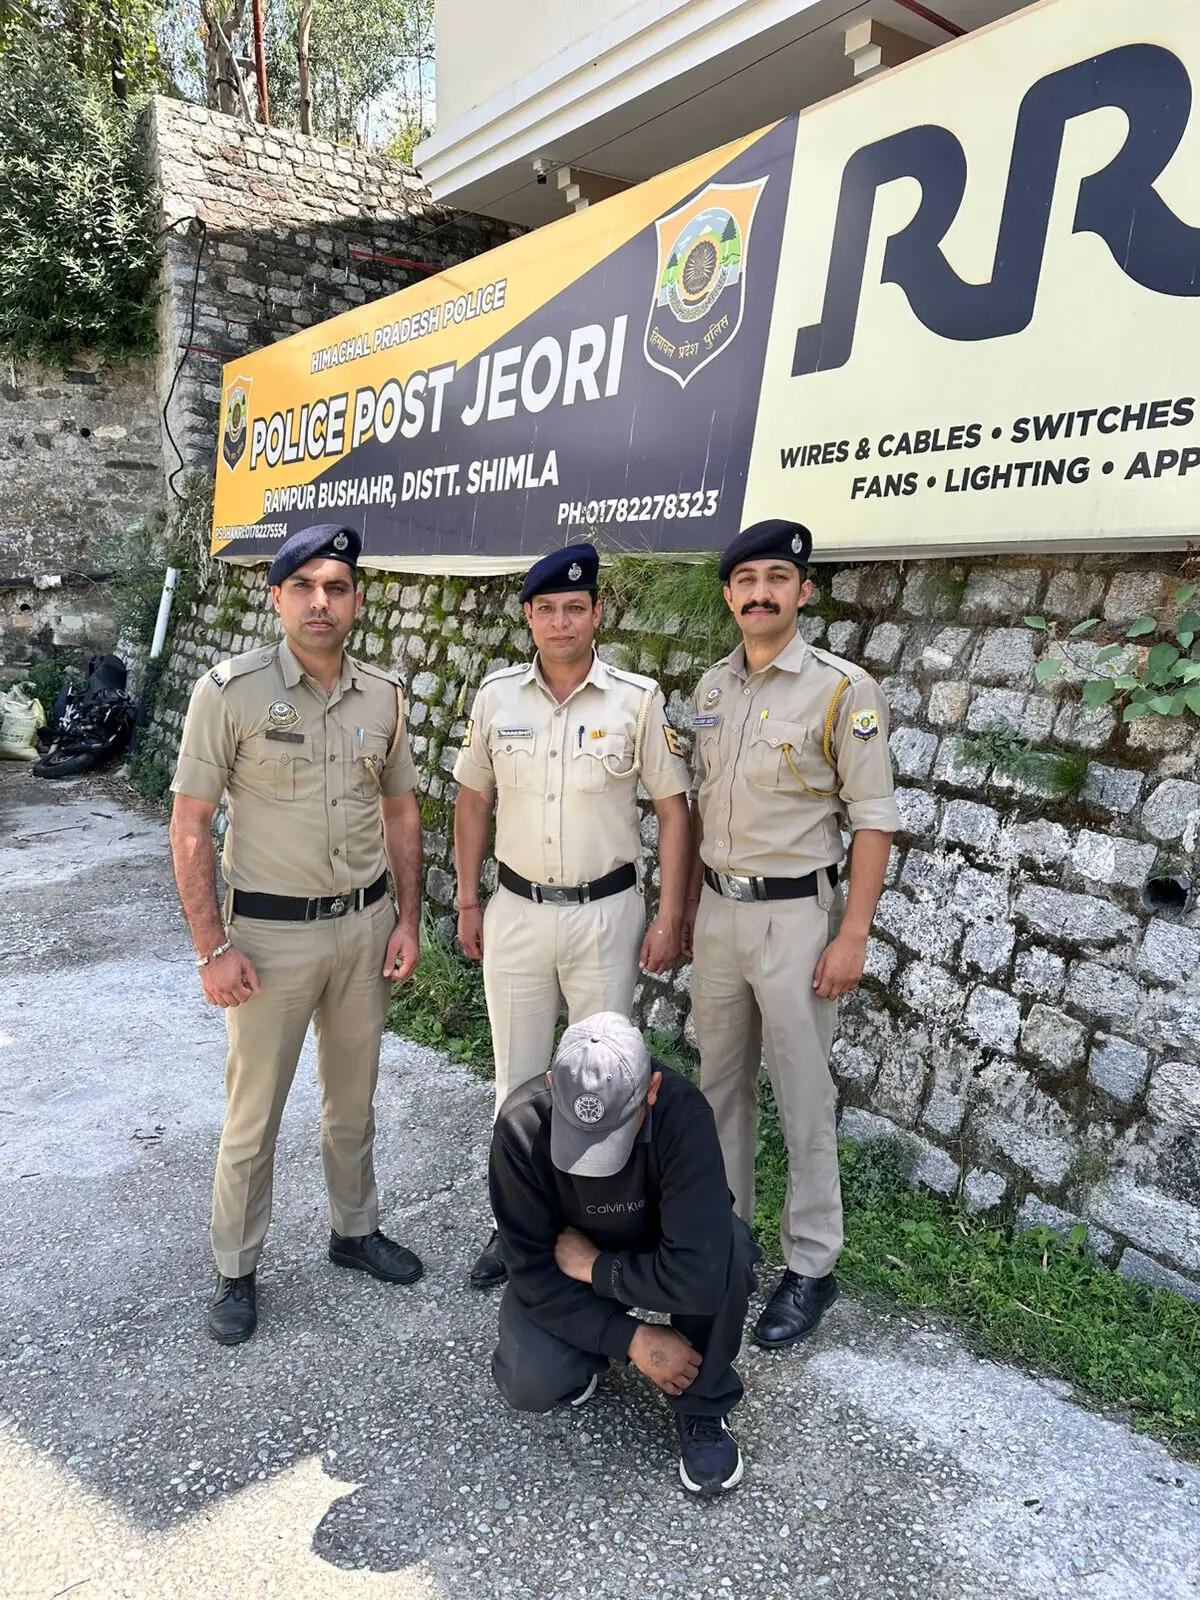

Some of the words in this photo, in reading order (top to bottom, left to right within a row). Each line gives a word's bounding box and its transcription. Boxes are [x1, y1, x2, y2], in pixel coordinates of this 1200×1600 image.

[310, 334, 371, 374] HIMACHAL
[373, 308, 440, 350] PRADESH
[442, 279, 507, 330] POLICE
[649, 326, 676, 360] हिमाचल
[678, 340, 700, 360] प्रदेश
[703, 313, 729, 350] पुलिस
[250, 393, 349, 471] POLICE
[351, 360, 457, 449] POST
[460, 314, 628, 426] JEORI
[780, 438, 849, 469] WIRES
[855, 437, 870, 460] &
[878, 423, 982, 459] CABLES
[1010, 397, 1195, 445] SWITCHES
[263, 484, 315, 514] RAMPUR
[318, 474, 397, 510] BUSHAHR,
[401, 464, 460, 502] DISTT.
[467, 450, 559, 495] SHIMLA
[850, 472, 918, 500] FANS
[944, 456, 1090, 494] LIGHTING
[557, 489, 719, 526] PH:01782278323
[586, 1201, 625, 1214] Calvin
